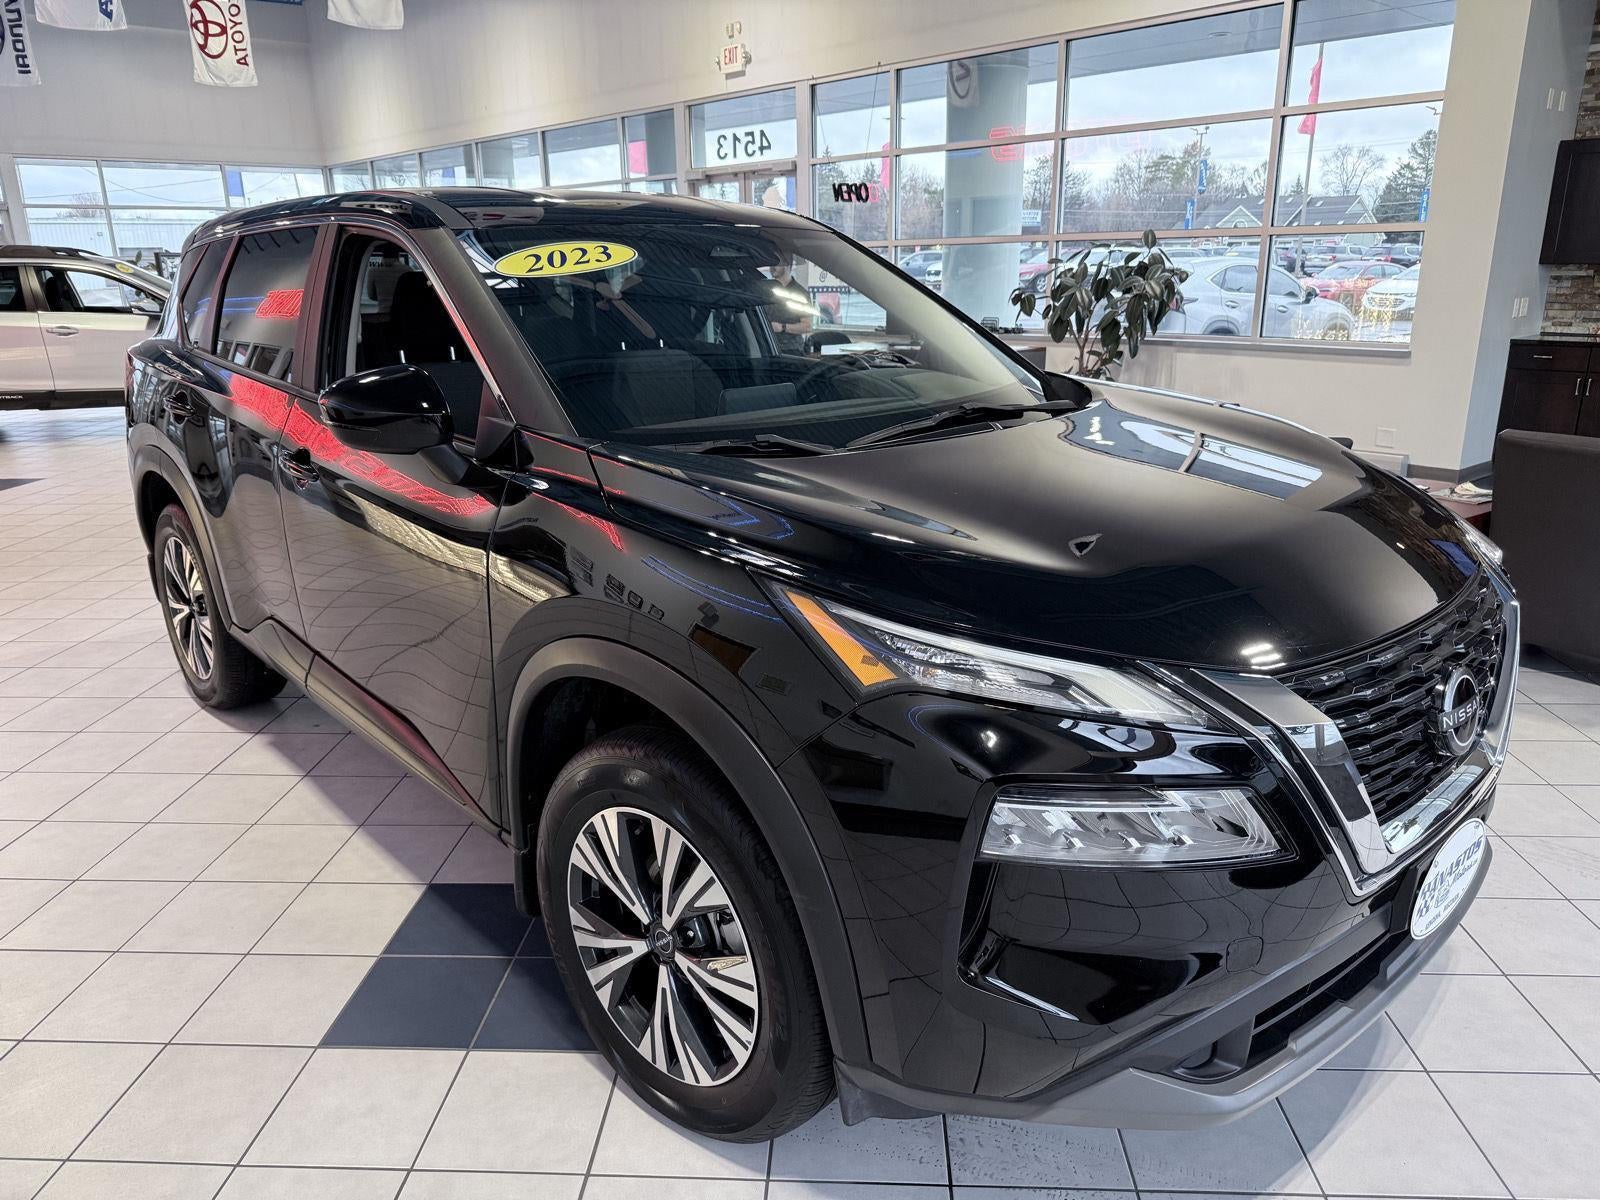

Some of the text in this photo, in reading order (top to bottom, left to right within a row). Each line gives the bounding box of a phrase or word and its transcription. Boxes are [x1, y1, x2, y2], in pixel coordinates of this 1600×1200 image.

[723, 45, 738, 65] EXIT
[523, 245, 613, 274] 2023
[1442, 699, 1479, 729] NISSA
